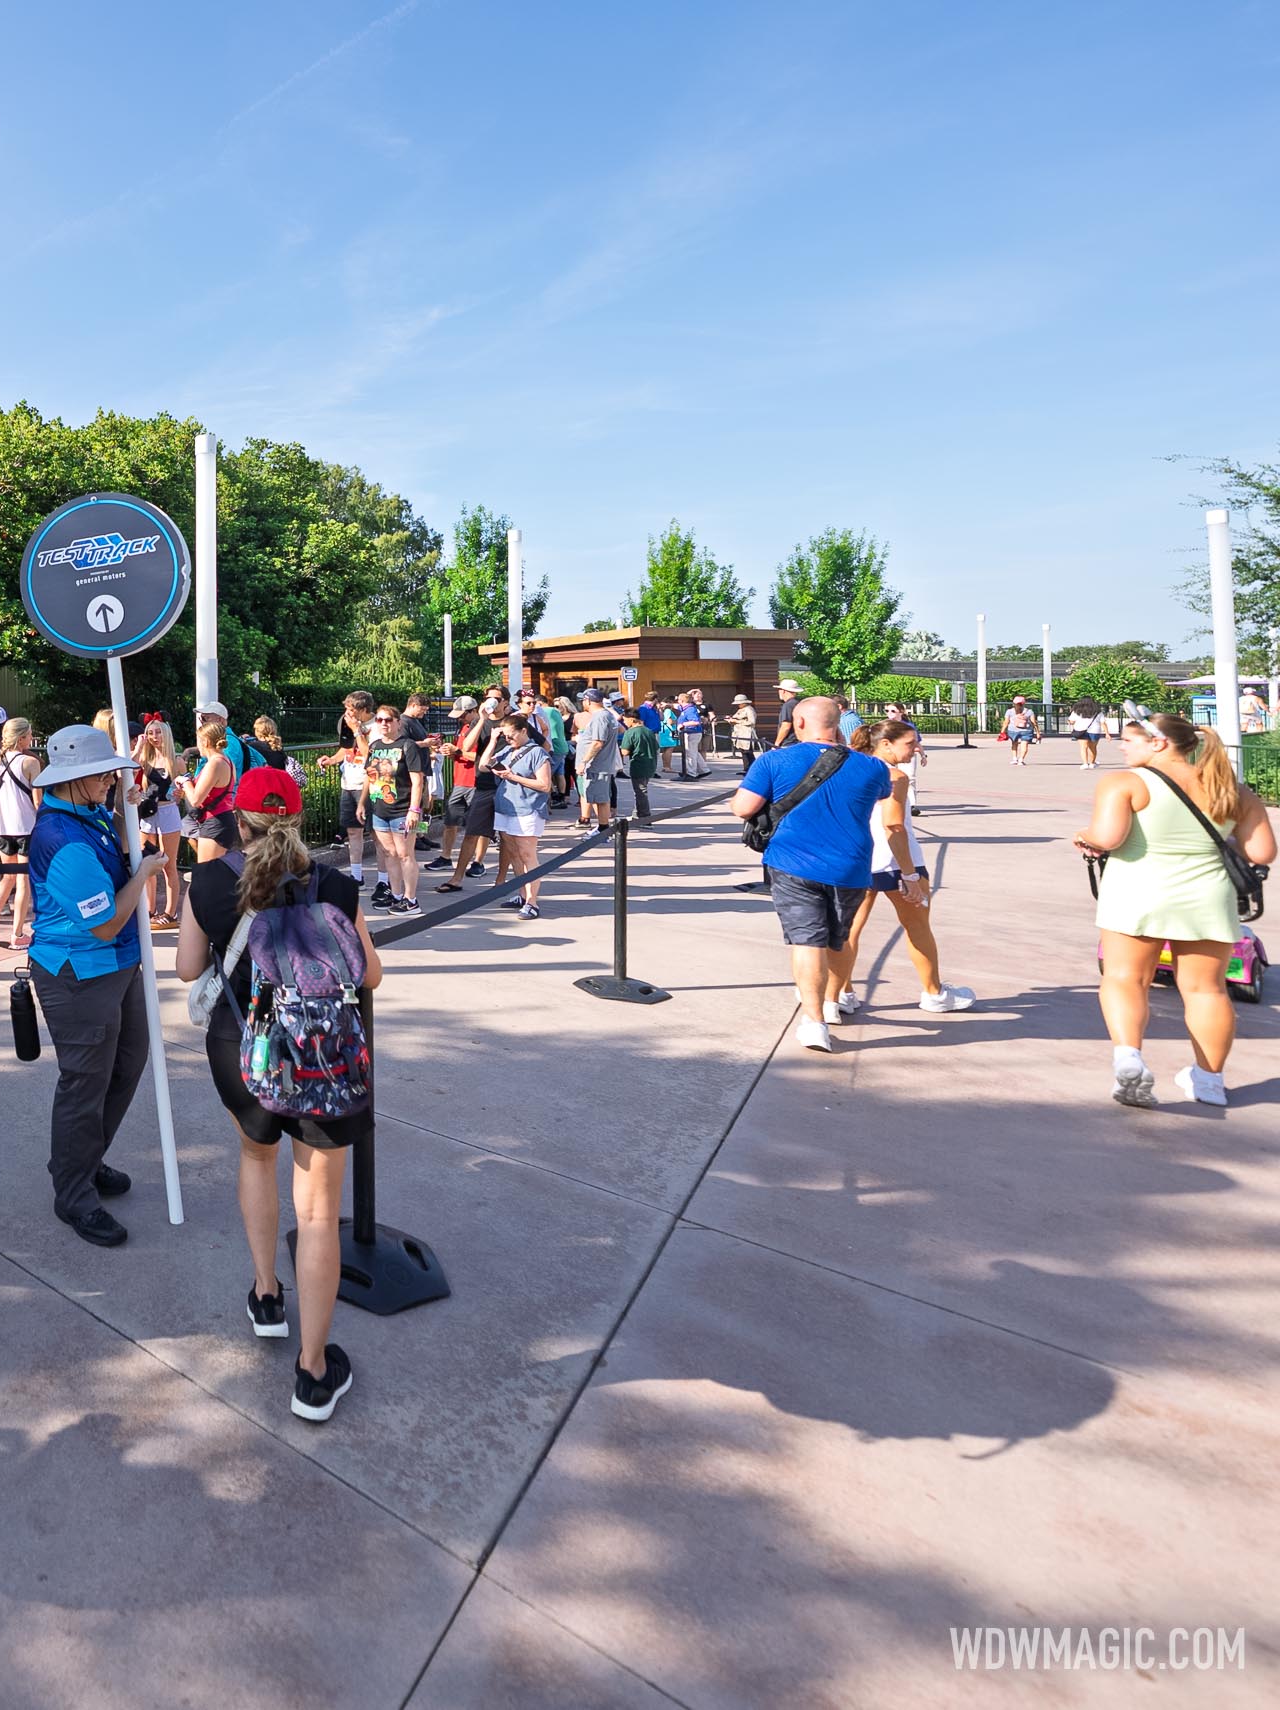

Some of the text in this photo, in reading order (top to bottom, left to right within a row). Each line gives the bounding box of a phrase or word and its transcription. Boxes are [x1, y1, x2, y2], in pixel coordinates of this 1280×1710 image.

[38, 535, 160, 567] TEST TRACK
[76, 574, 101, 587] general
[103, 572, 126, 582] motors
